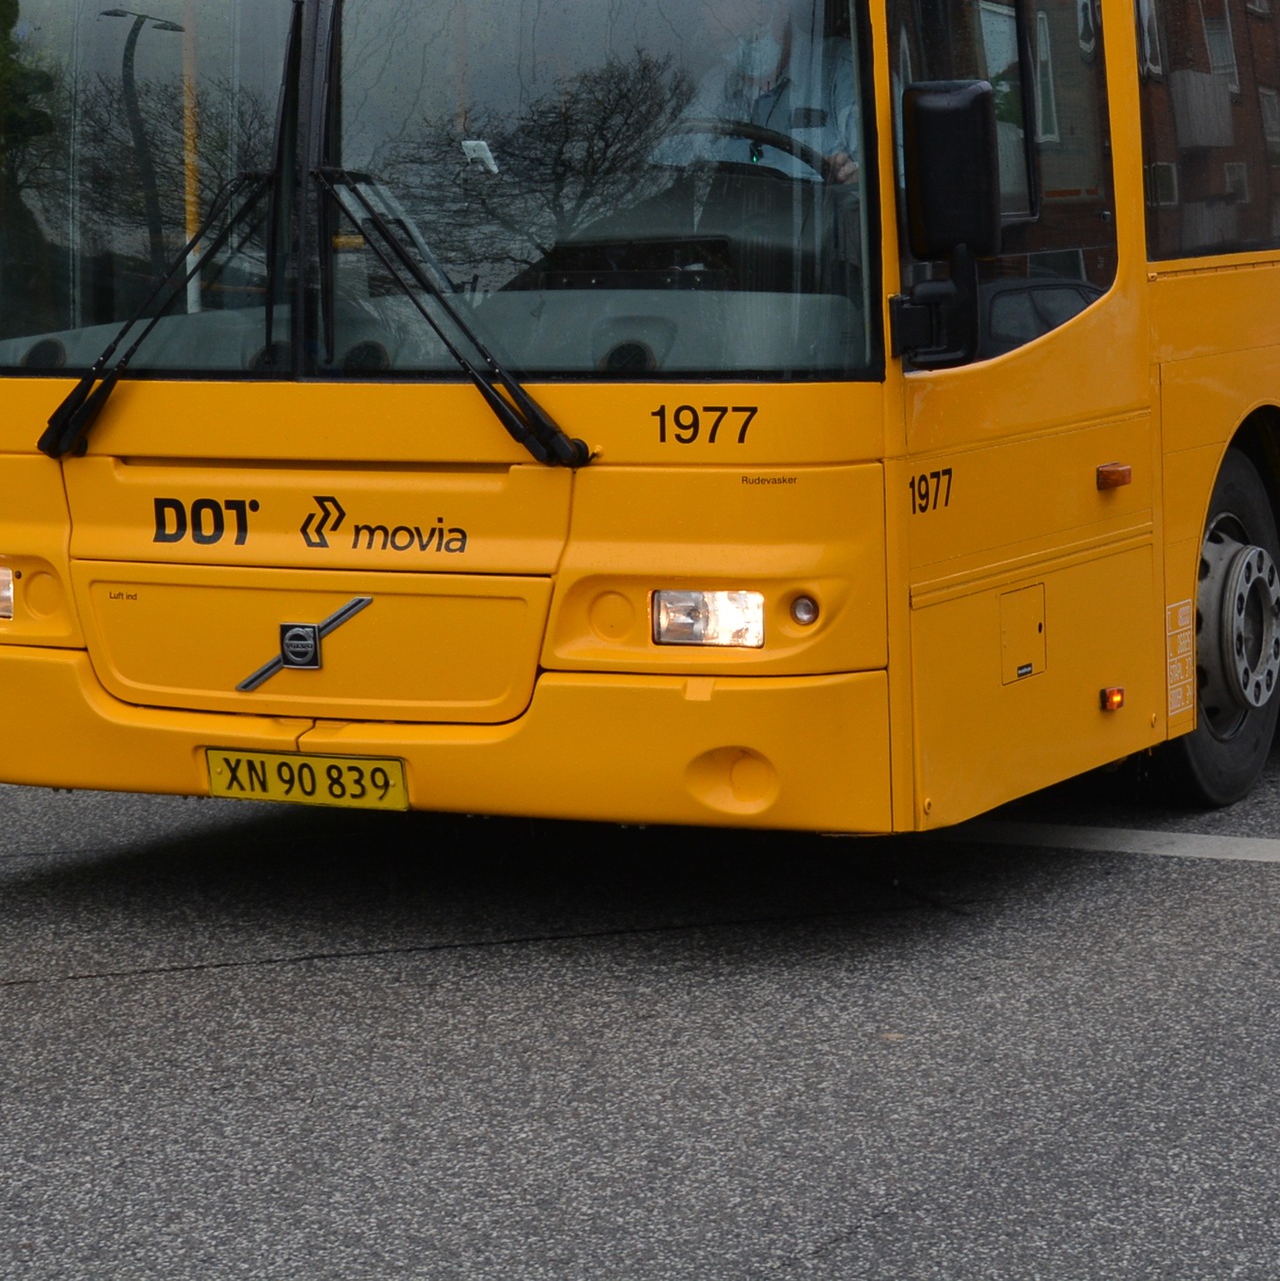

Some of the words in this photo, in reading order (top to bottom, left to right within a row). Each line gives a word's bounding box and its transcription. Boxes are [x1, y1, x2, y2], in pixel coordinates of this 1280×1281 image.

[651, 405, 758, 444] 1977
[741, 475, 797, 485] Rudevasker
[909, 468, 953, 515] 1977
[153, 497, 260, 546] DOT
[351, 517, 468, 553] movia
[109, 591, 124, 600] Luft
[125, 592, 137, 600] ind
[223, 757, 269, 793] XN
[277, 761, 317, 797] 90
[326, 764, 390, 801] 839
